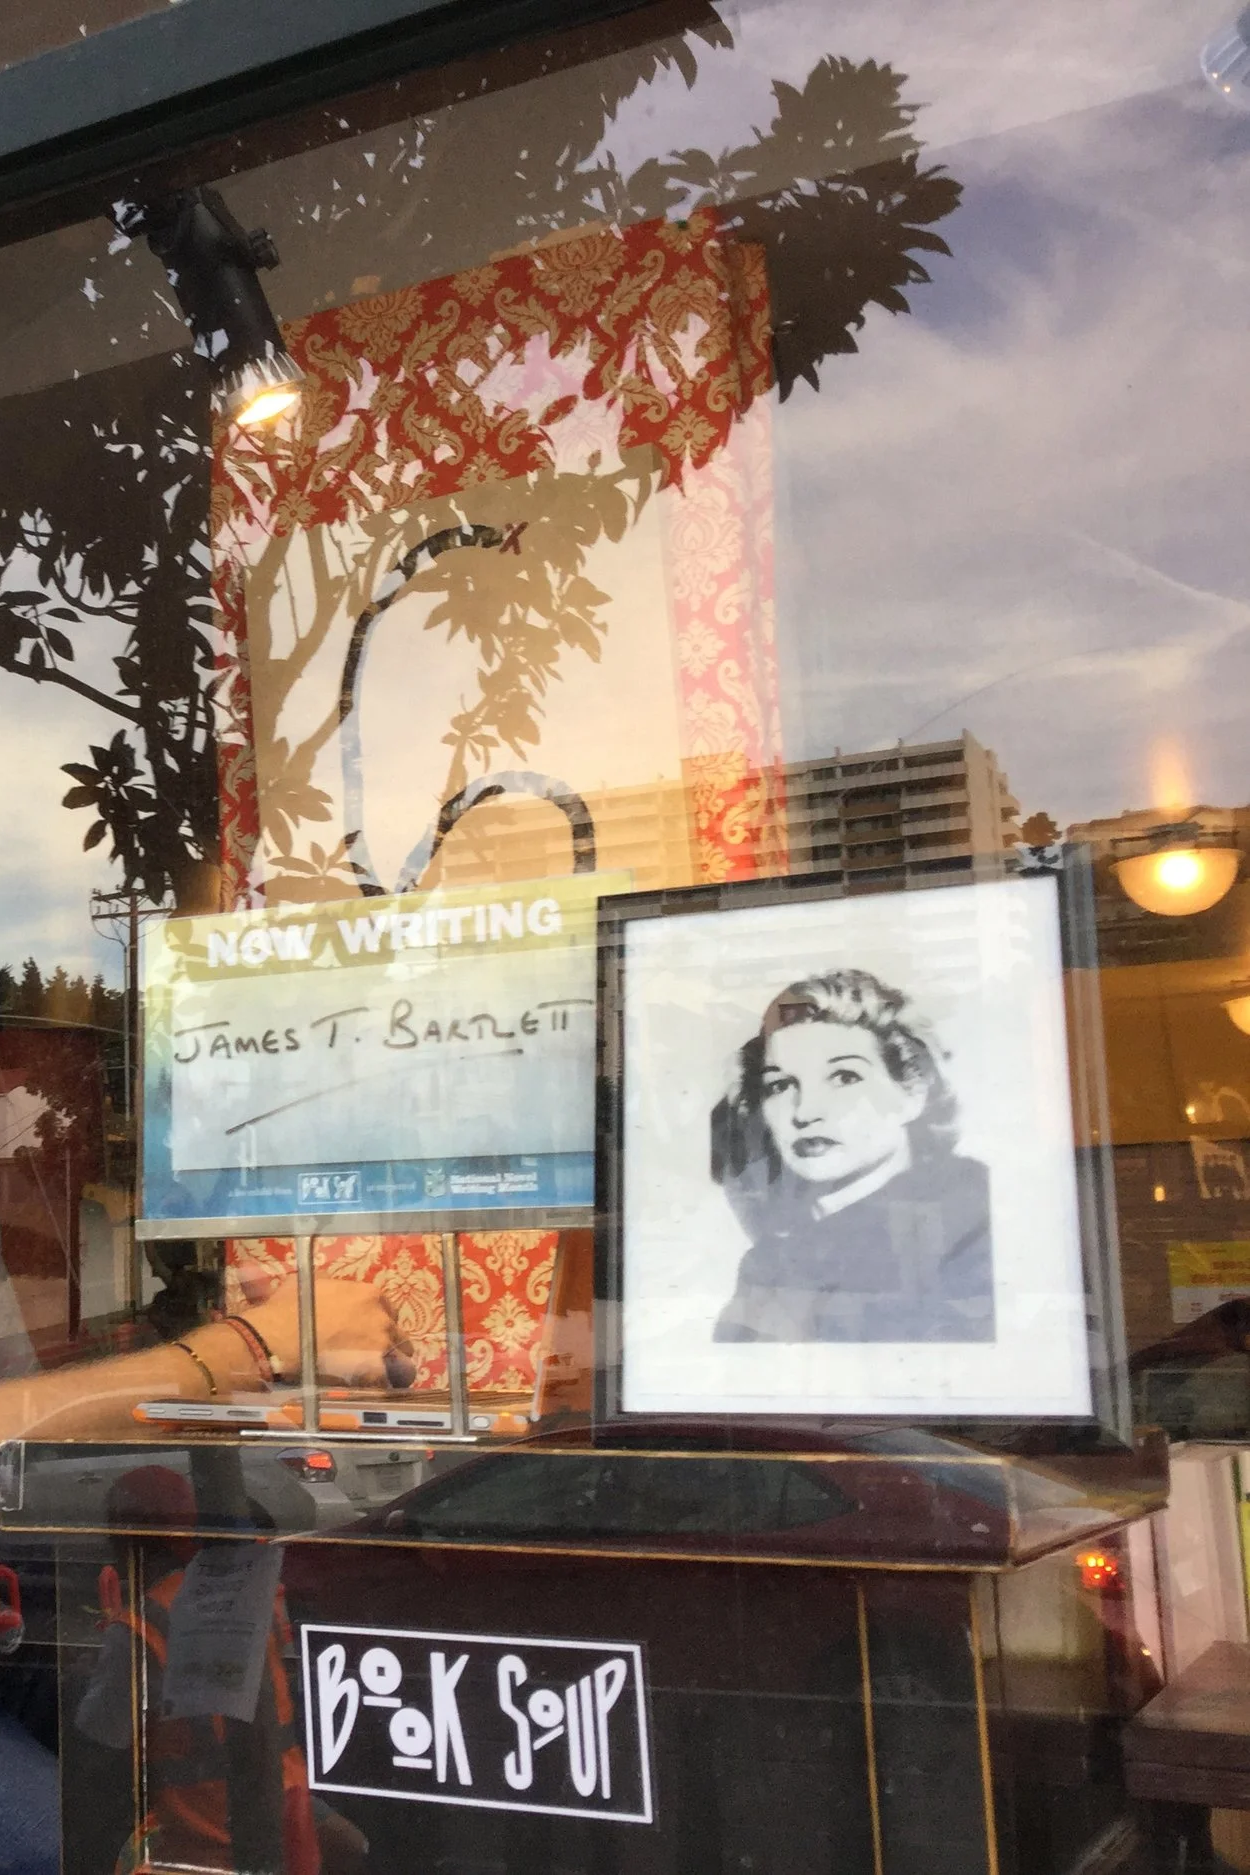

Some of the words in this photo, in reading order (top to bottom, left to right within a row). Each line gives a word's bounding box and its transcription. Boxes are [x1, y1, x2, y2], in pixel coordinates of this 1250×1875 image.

[207, 922, 317, 969] NOW
[337, 897, 563, 955] WRITING
[173, 1020, 300, 1064] JAMES
[311, 1006, 370, 1048] T.
[316, 1643, 474, 1786] BOOK
[496, 1654, 628, 1800] SOUP
